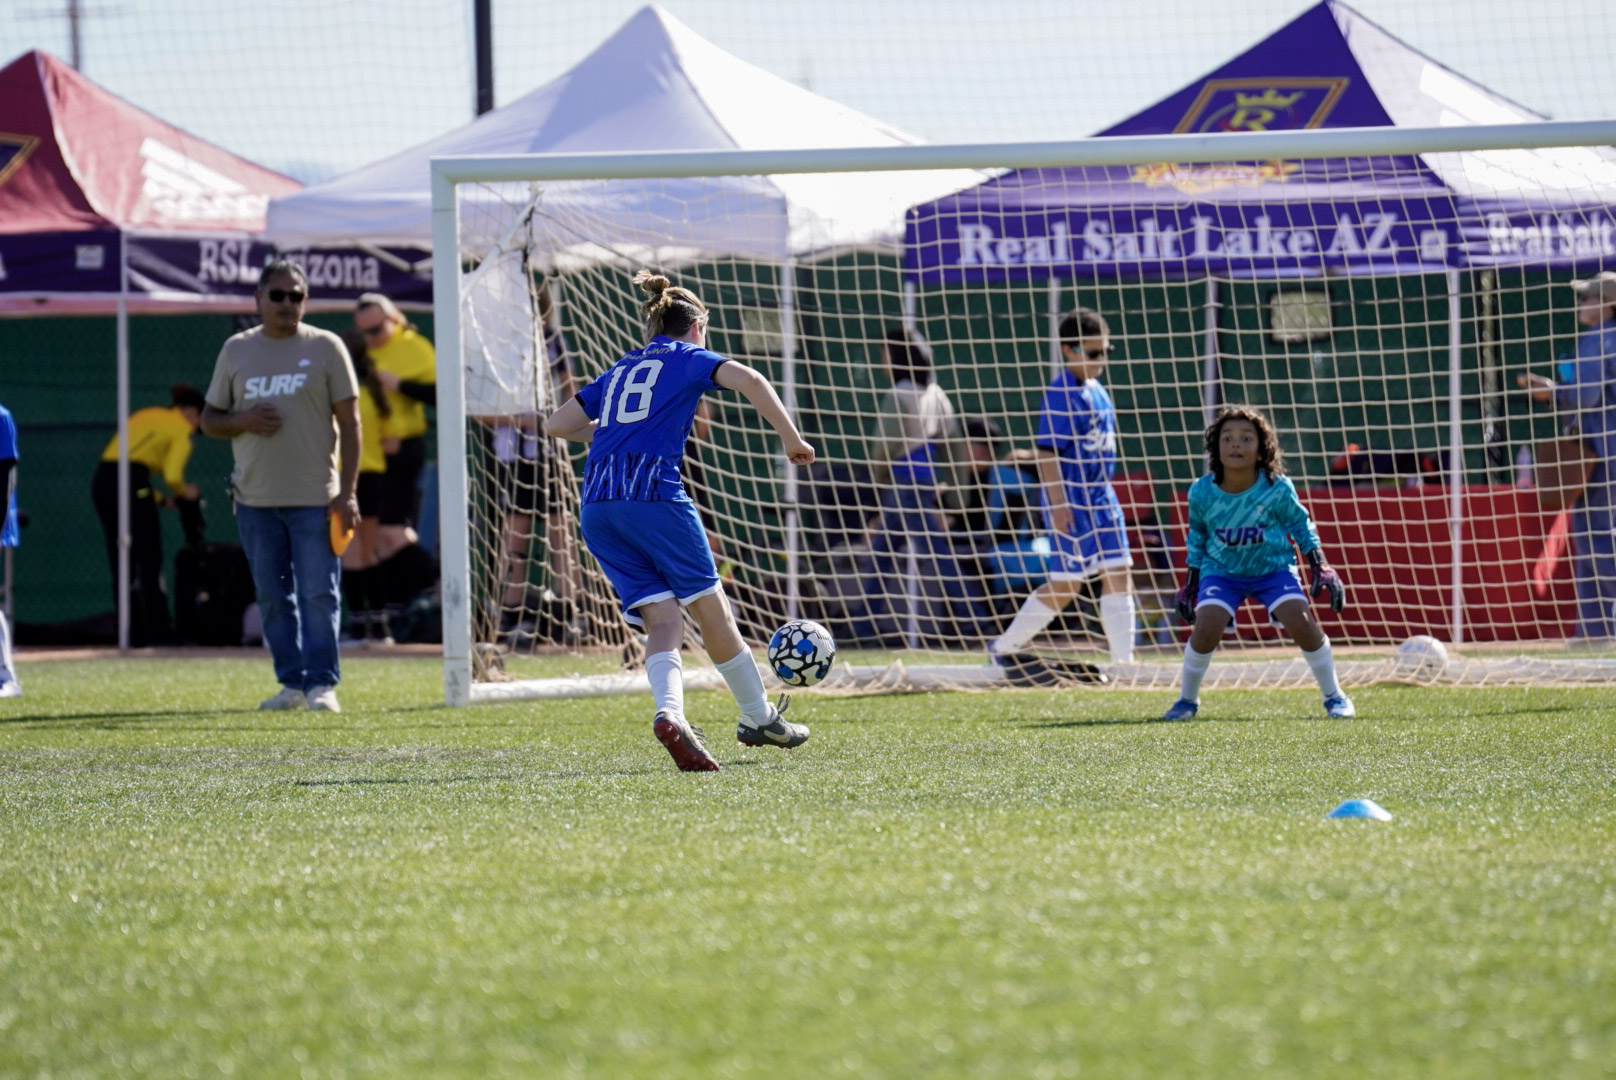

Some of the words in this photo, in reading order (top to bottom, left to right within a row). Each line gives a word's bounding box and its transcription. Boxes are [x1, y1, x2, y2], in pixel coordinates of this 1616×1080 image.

[956, 222, 1069, 265] Real
[1083, 219, 1179, 260] Salt
[1190, 216, 1316, 259] Lake
[1327, 212, 1399, 257] AZ
[1487, 212, 1555, 257] Real
[1558, 211, 1614, 256] Salt
[198, 240, 260, 283] RSL
[243, 372, 308, 400] SURF
[600, 358, 665, 428] 18
